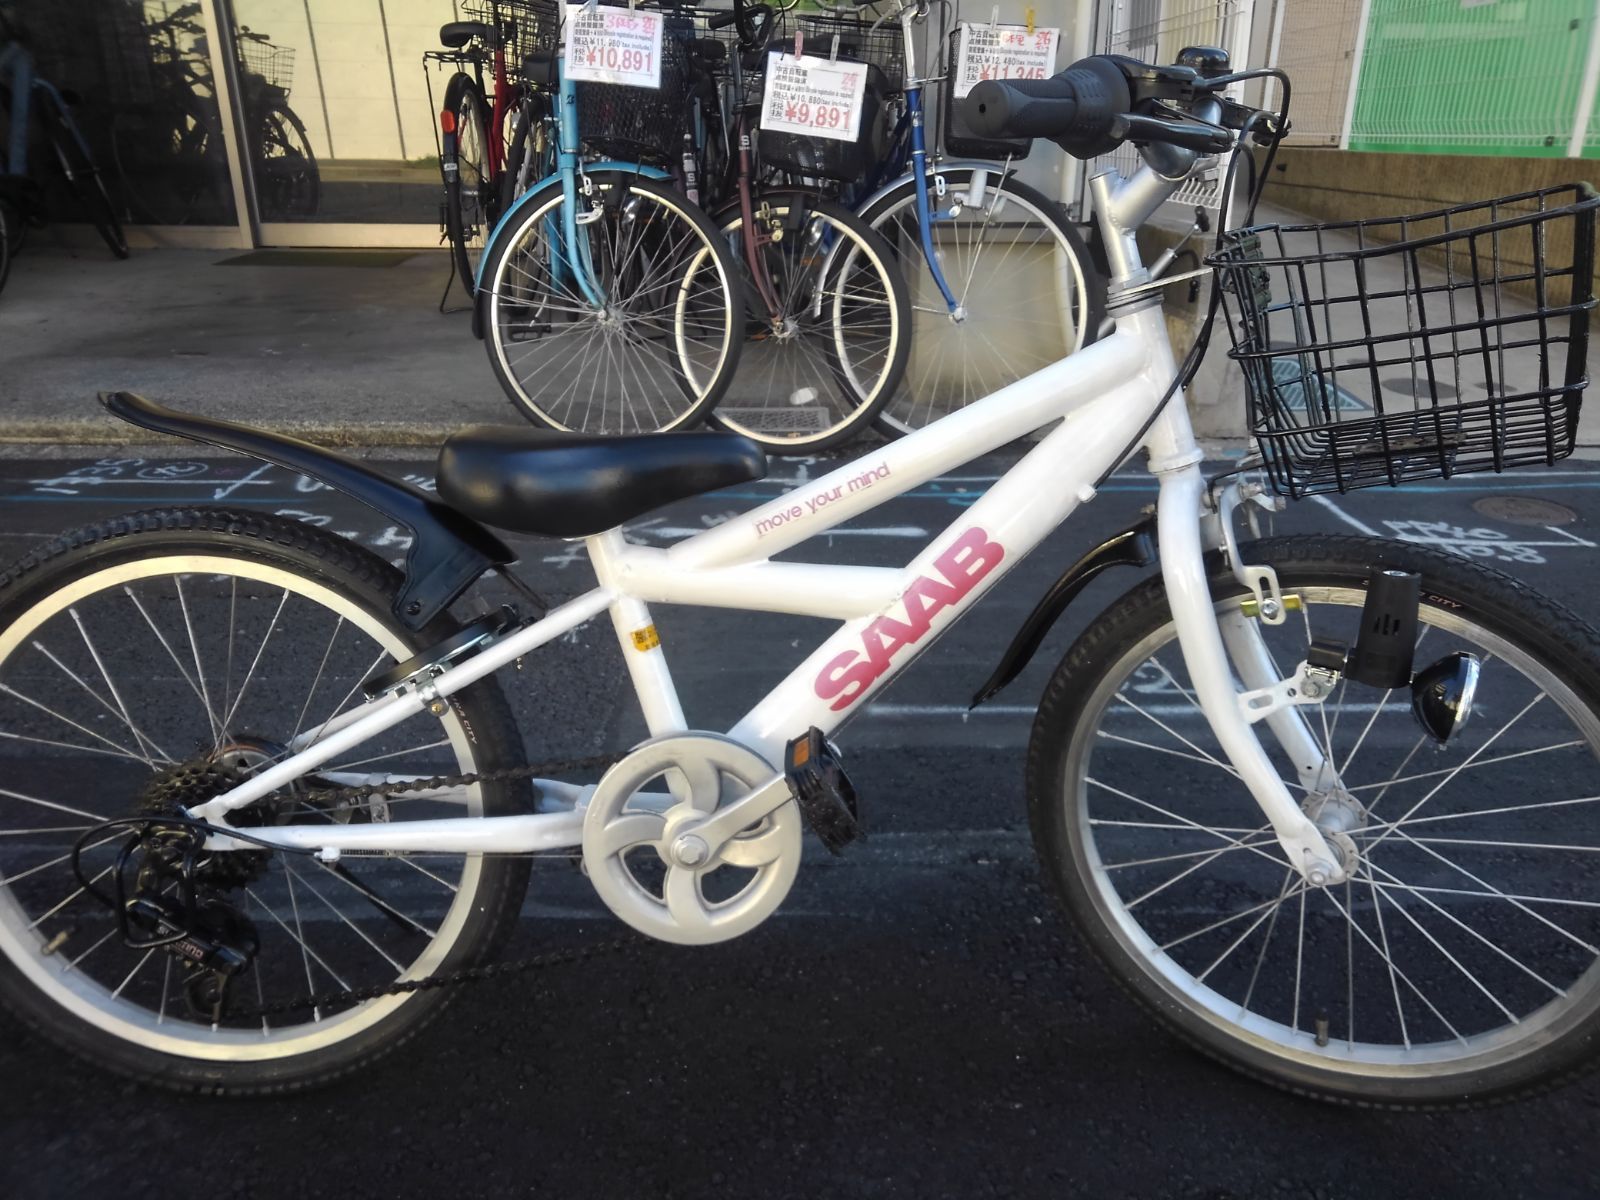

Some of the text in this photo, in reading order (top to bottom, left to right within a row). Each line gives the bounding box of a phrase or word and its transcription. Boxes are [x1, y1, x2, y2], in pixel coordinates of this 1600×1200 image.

[586, 46, 652, 73] ¥10,891
[785, 101, 851, 130] ¥9,891
[755, 461, 891, 535] move your mind
[1429, 594, 1463, 609] CITY
[814, 526, 1005, 712] SAAB
